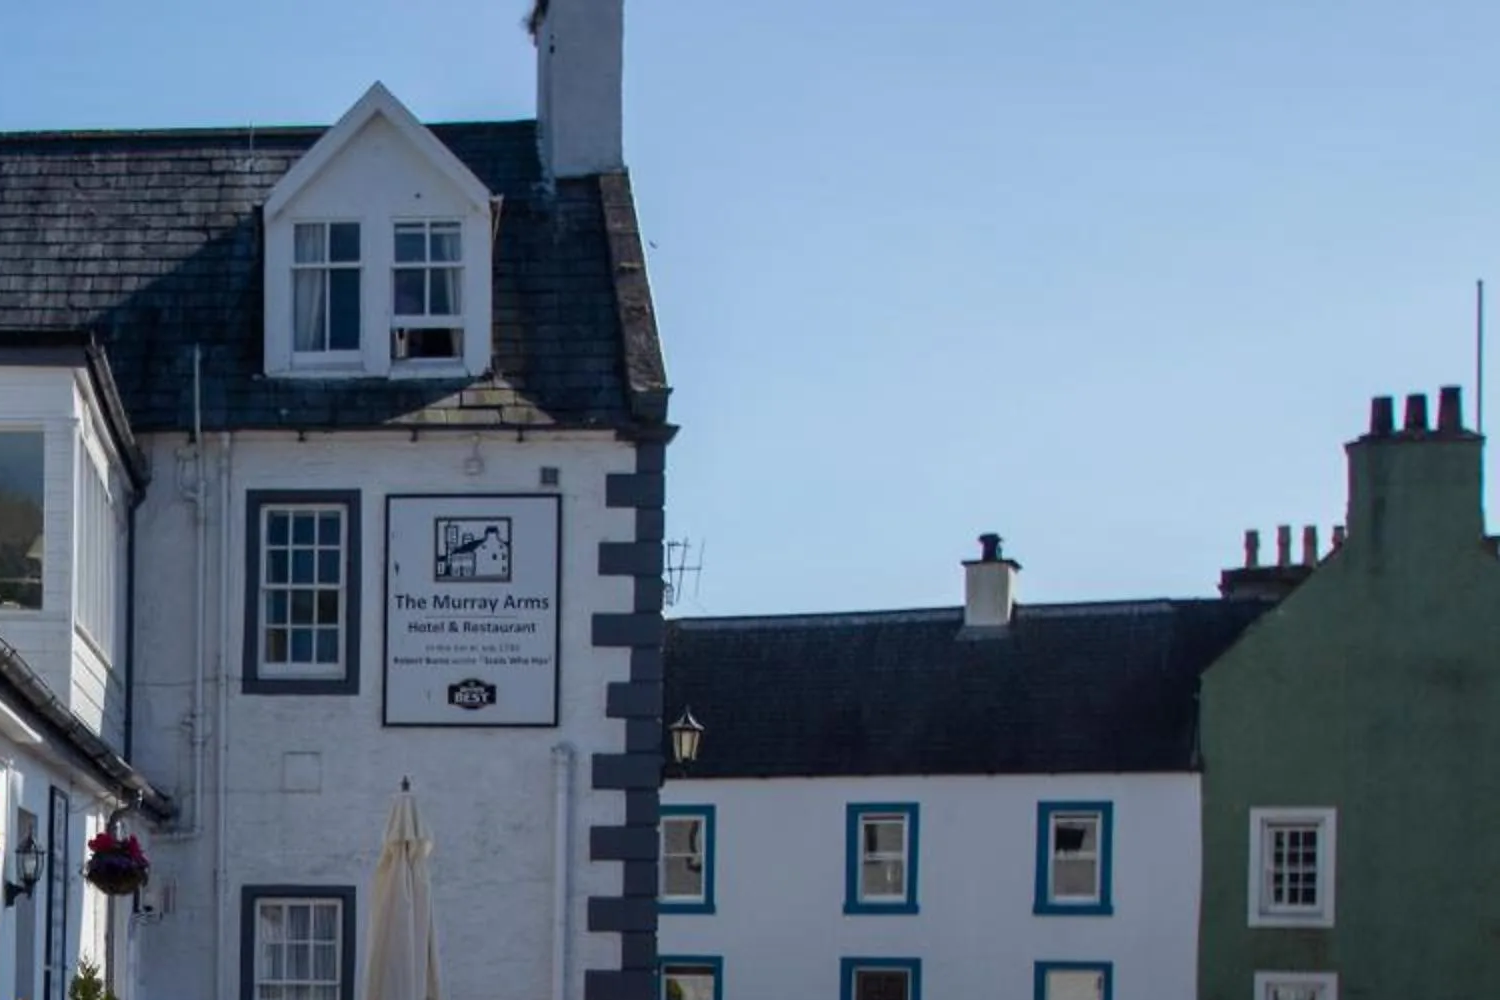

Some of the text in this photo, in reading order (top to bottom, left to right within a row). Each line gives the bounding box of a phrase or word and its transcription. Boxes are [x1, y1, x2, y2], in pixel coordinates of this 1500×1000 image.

[395, 594, 549, 613] The Murray Arms
[408, 621, 537, 633] Hotel & Restaurant
